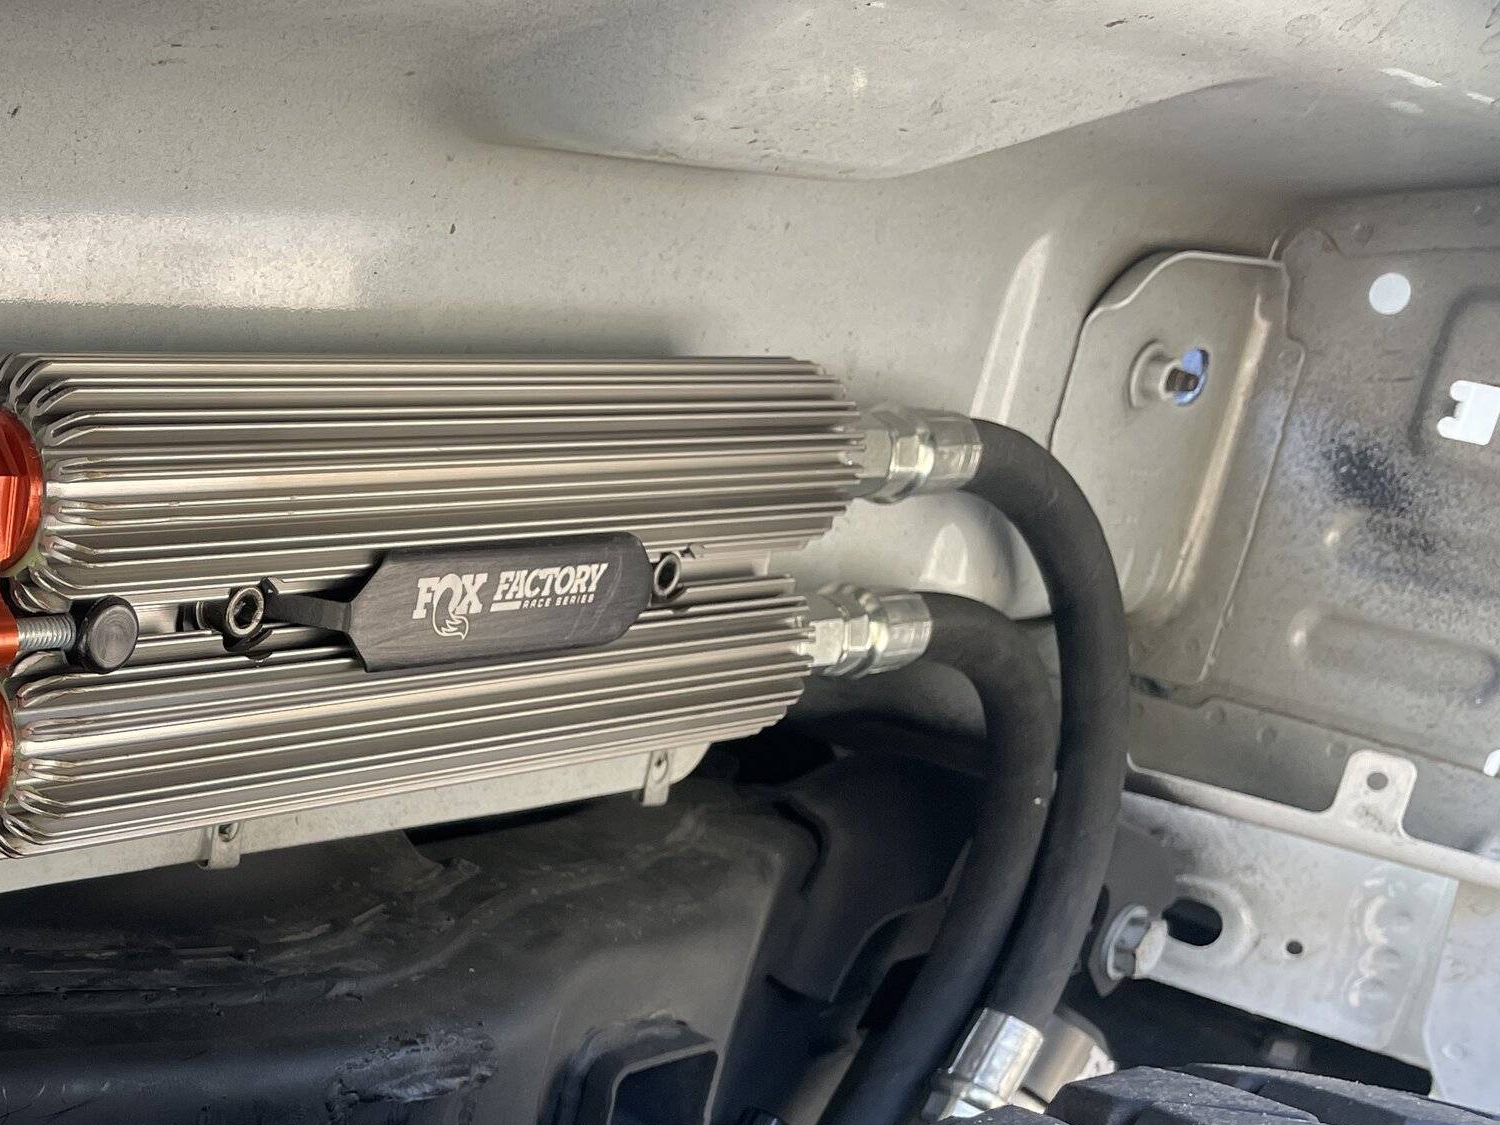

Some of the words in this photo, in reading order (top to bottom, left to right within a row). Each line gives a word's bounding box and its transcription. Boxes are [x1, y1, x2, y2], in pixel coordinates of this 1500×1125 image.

[411, 572, 488, 640] FOX
[493, 562, 609, 602] FACTORY
[522, 597, 552, 609] RACE
[555, 593, 595, 606] SERIES
